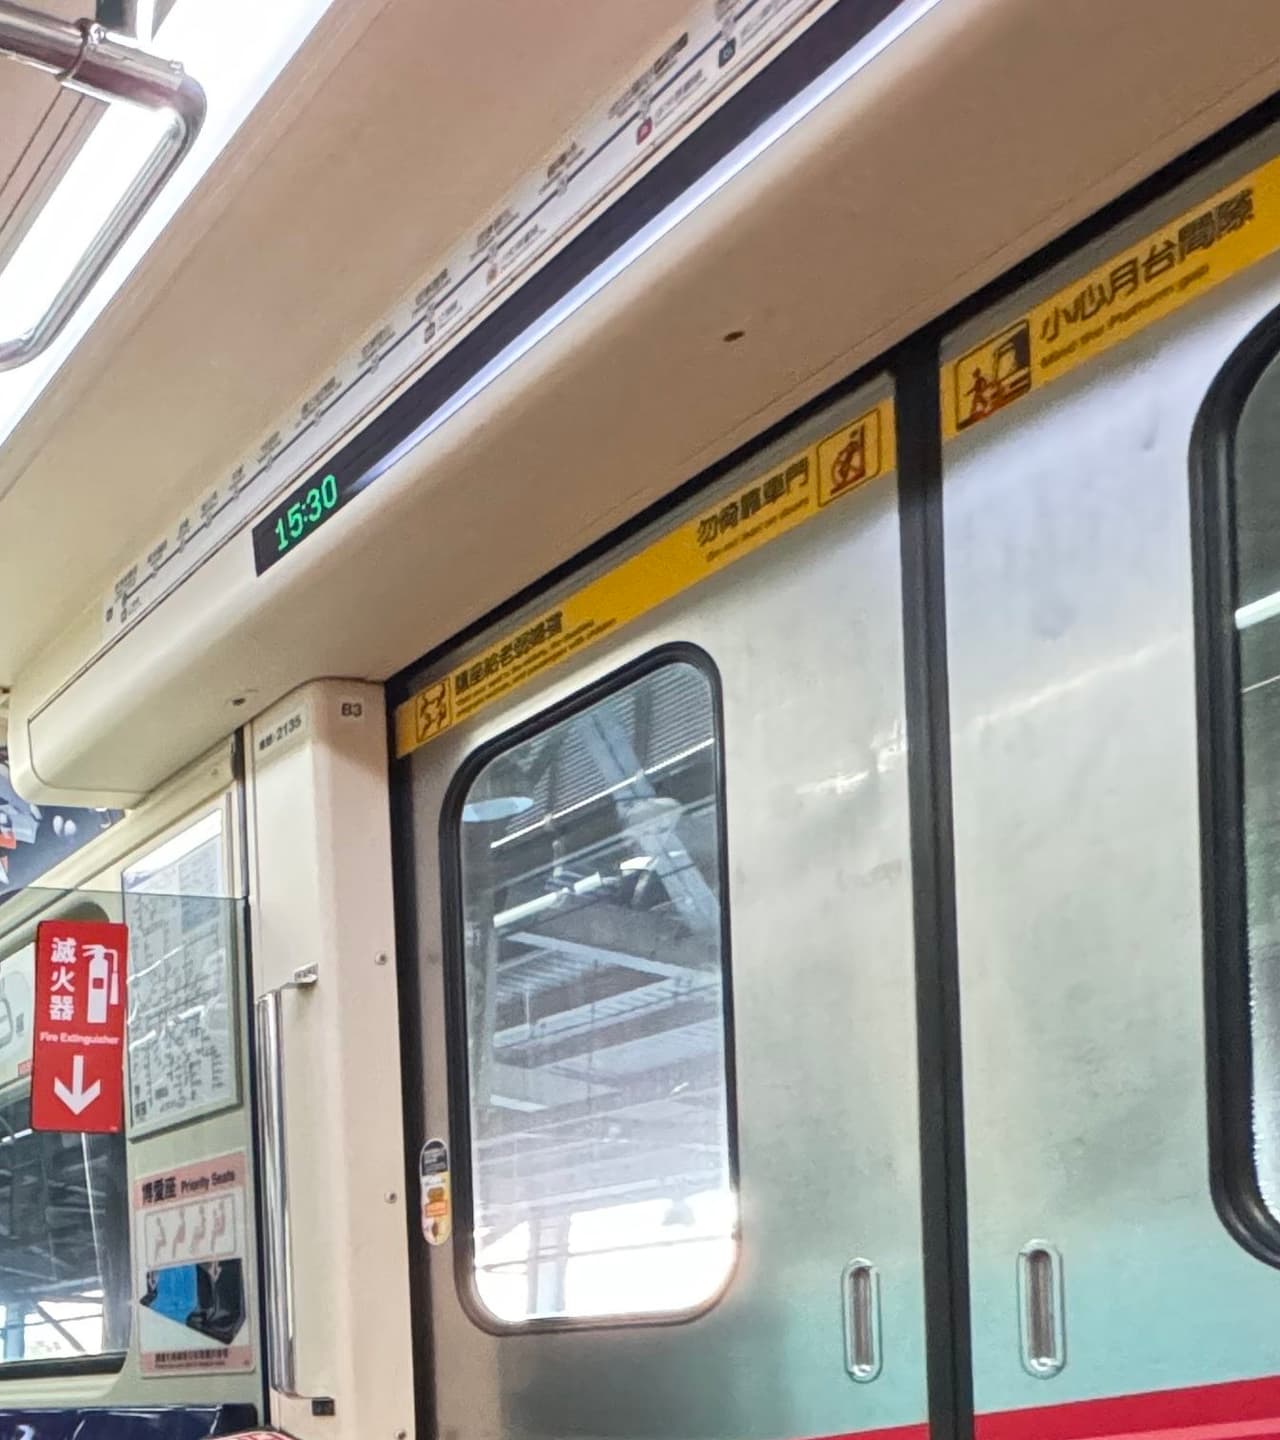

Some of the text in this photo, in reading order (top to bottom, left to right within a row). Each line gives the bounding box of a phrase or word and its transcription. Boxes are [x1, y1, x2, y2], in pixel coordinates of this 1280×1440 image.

[275, 473, 338, 551] 15:30
[341, 702, 363, 718] B3
[49, 937, 78, 1022] 滅火器
[40, 1031, 120, 1046] Fire Extinguisher
